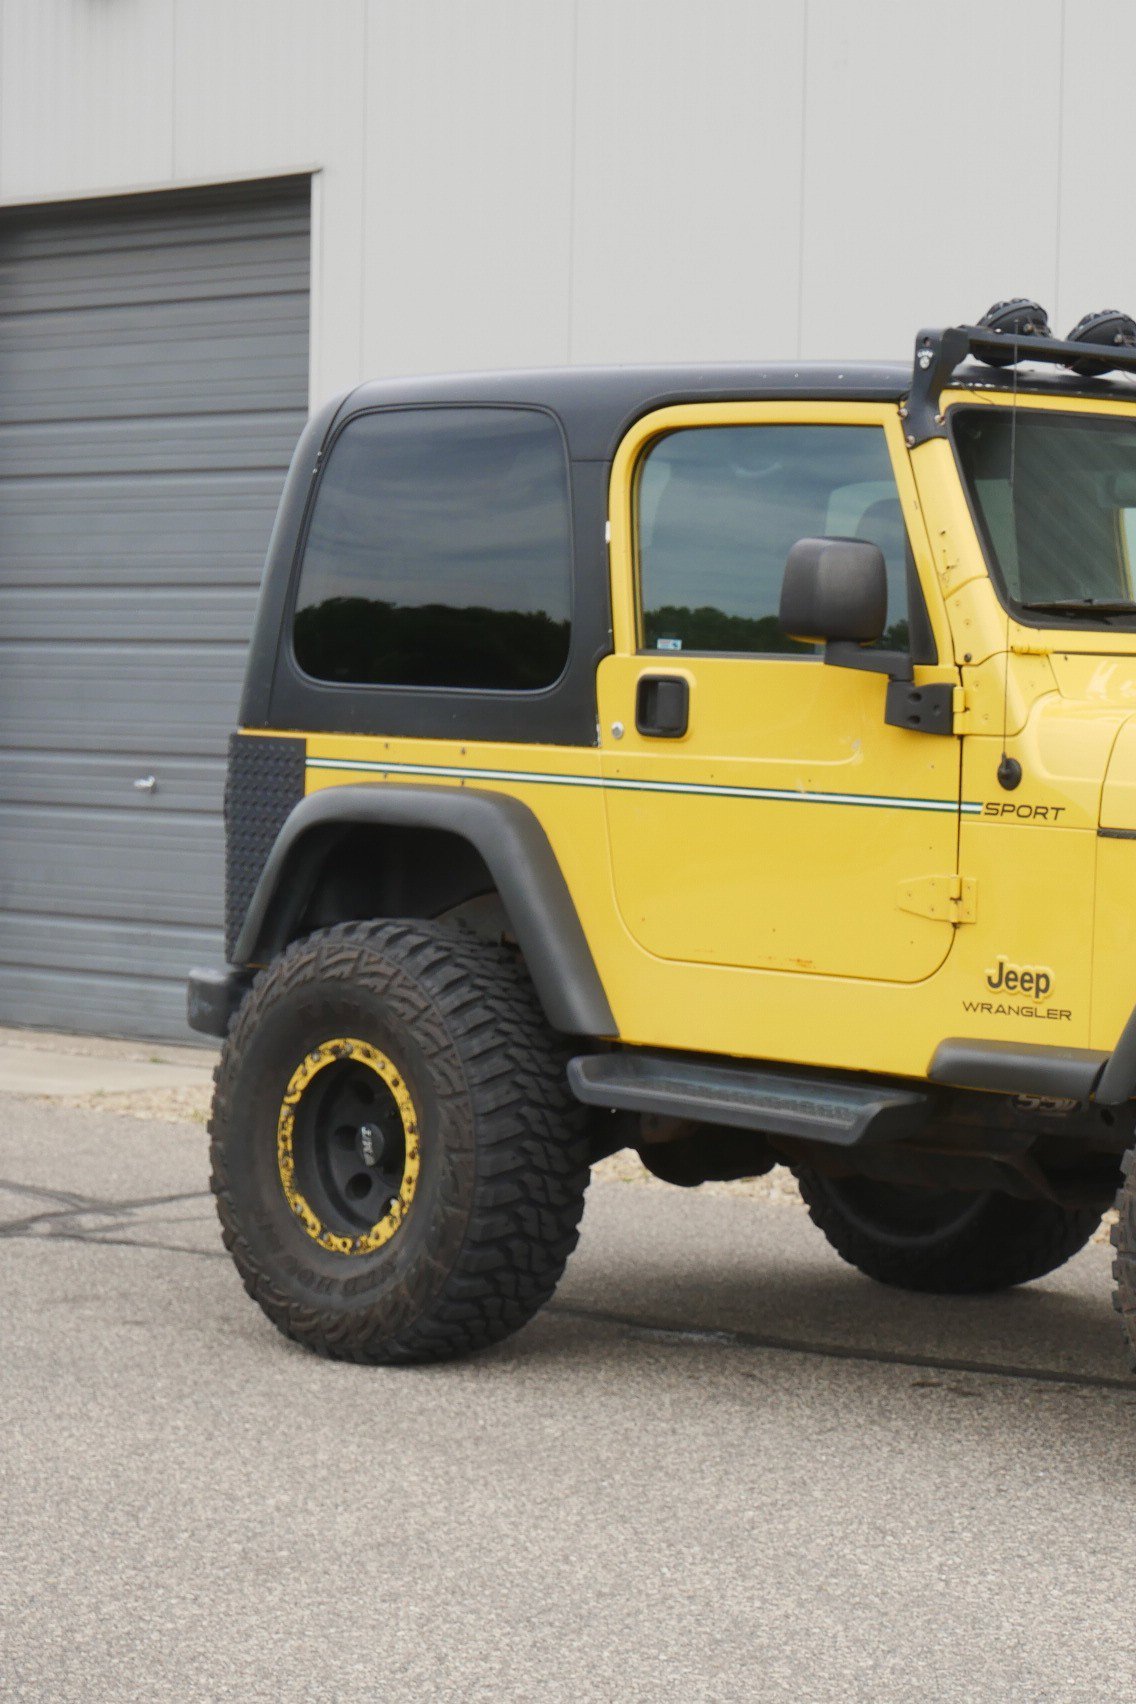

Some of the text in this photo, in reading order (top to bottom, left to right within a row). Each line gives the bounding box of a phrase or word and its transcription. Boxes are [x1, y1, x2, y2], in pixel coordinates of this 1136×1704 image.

[984, 802, 1066, 821] SPORT
[986, 961, 1051, 999] Jeep
[962, 1000, 1073, 1021] WRANGLER
